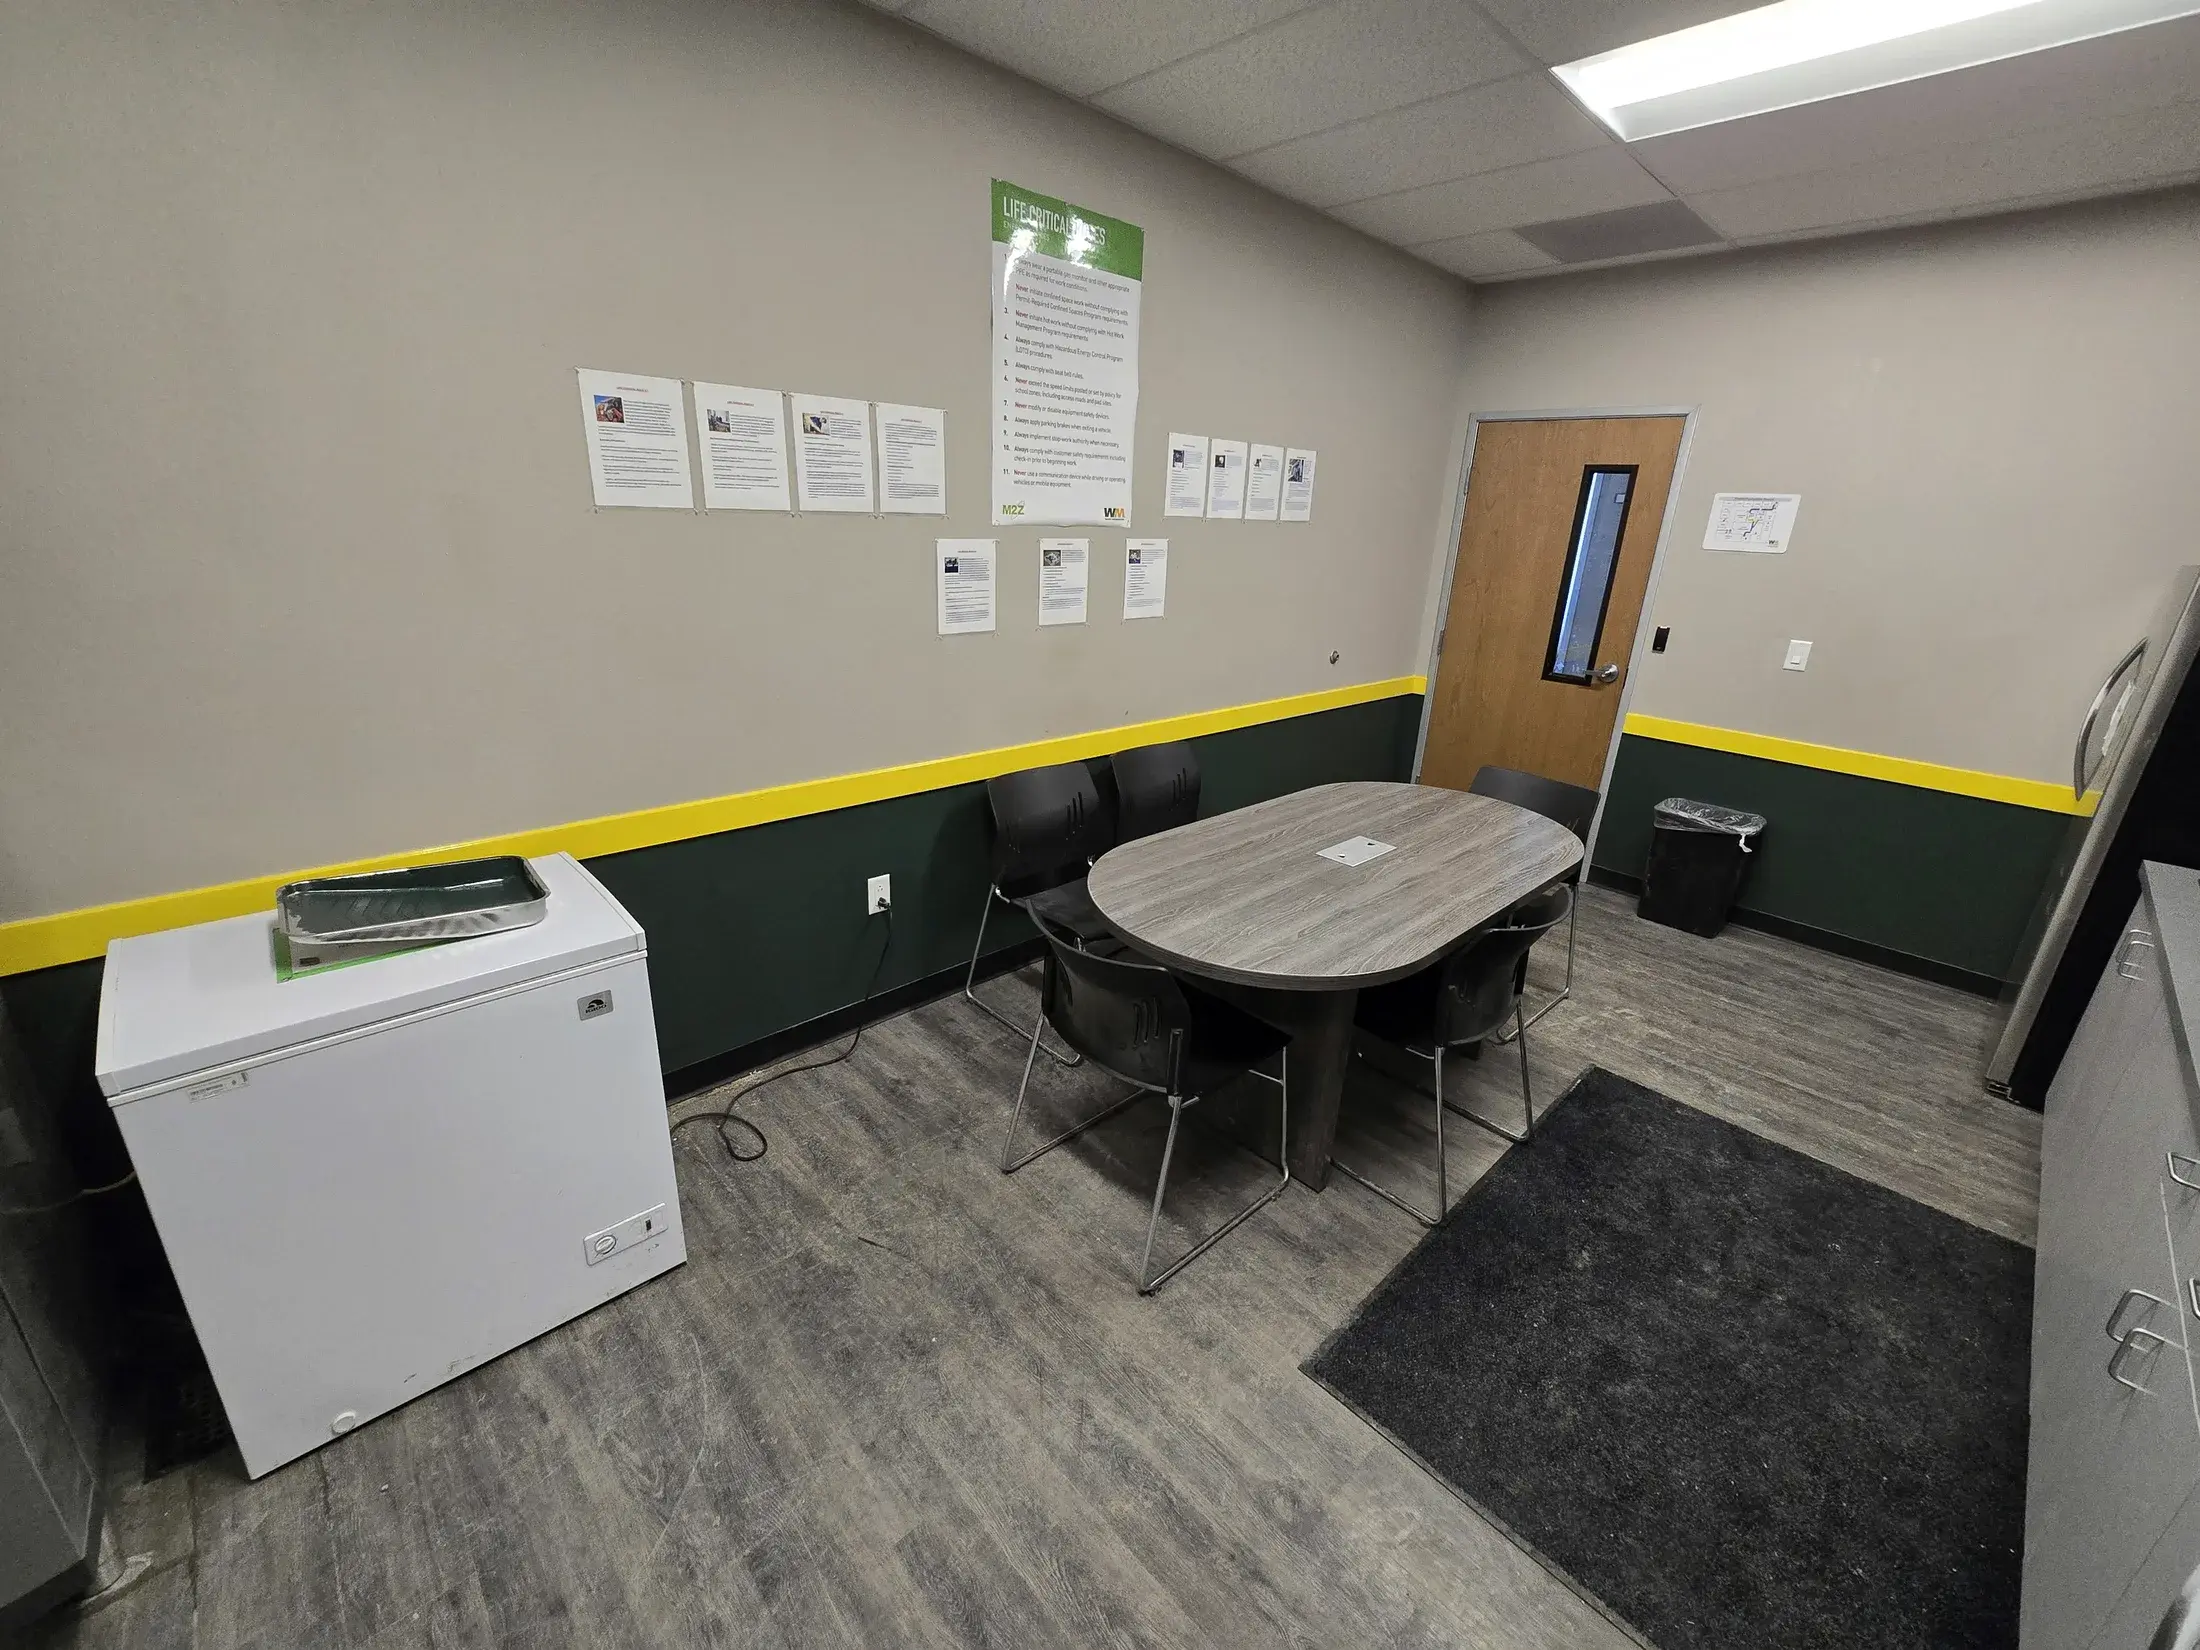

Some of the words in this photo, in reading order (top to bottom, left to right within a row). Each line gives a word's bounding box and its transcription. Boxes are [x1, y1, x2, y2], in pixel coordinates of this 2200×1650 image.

[1003, 196, 1027, 220] LIFE
[1030, 205, 1071, 238] CRITICAL
[1002, 504, 1024, 515] M2Z
[1104, 507, 1124, 518] WM
